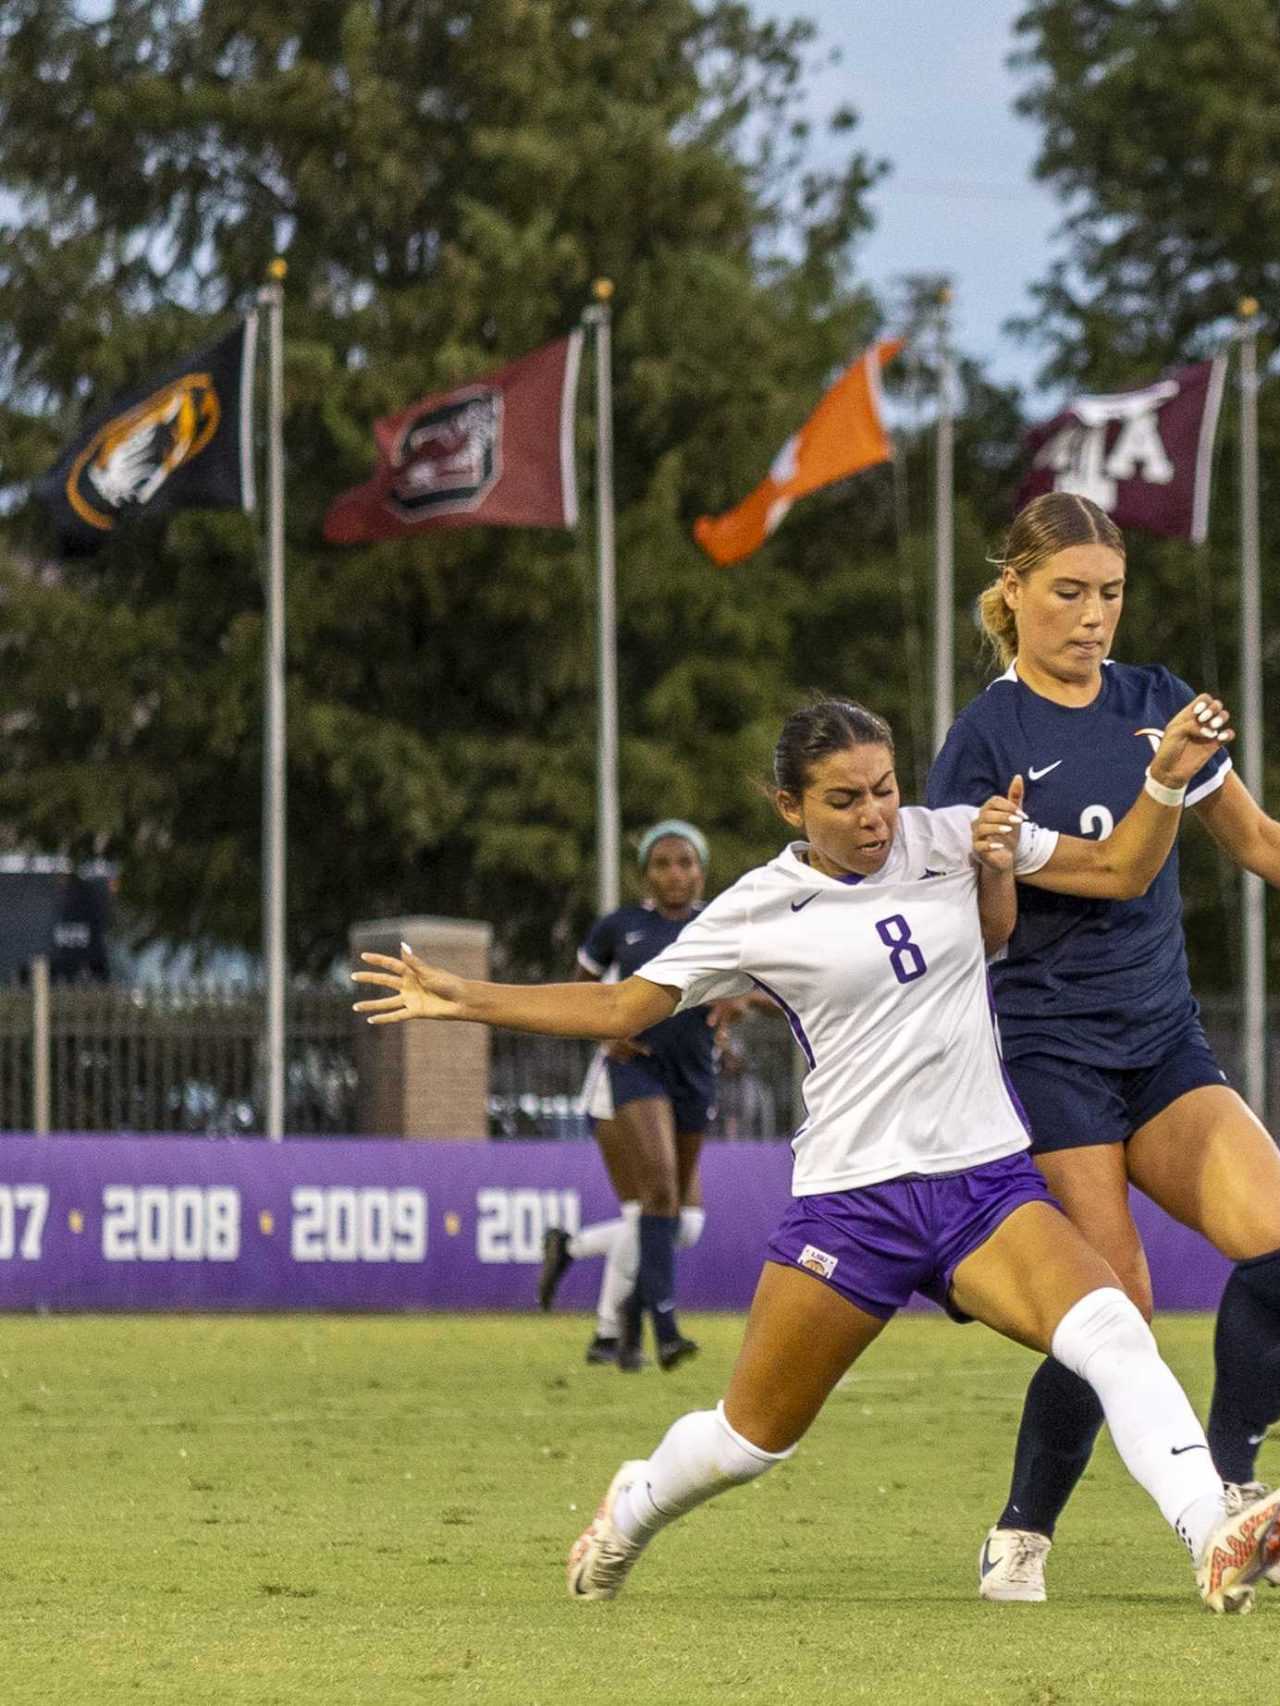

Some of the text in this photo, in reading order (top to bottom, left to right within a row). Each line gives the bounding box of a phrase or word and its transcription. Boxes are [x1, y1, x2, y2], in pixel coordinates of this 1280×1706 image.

[1080, 804, 1114, 841] 2
[875, 914, 928, 984] 8
[102, 1184, 241, 1262] 2008
[291, 1186, 427, 1263] 2009
